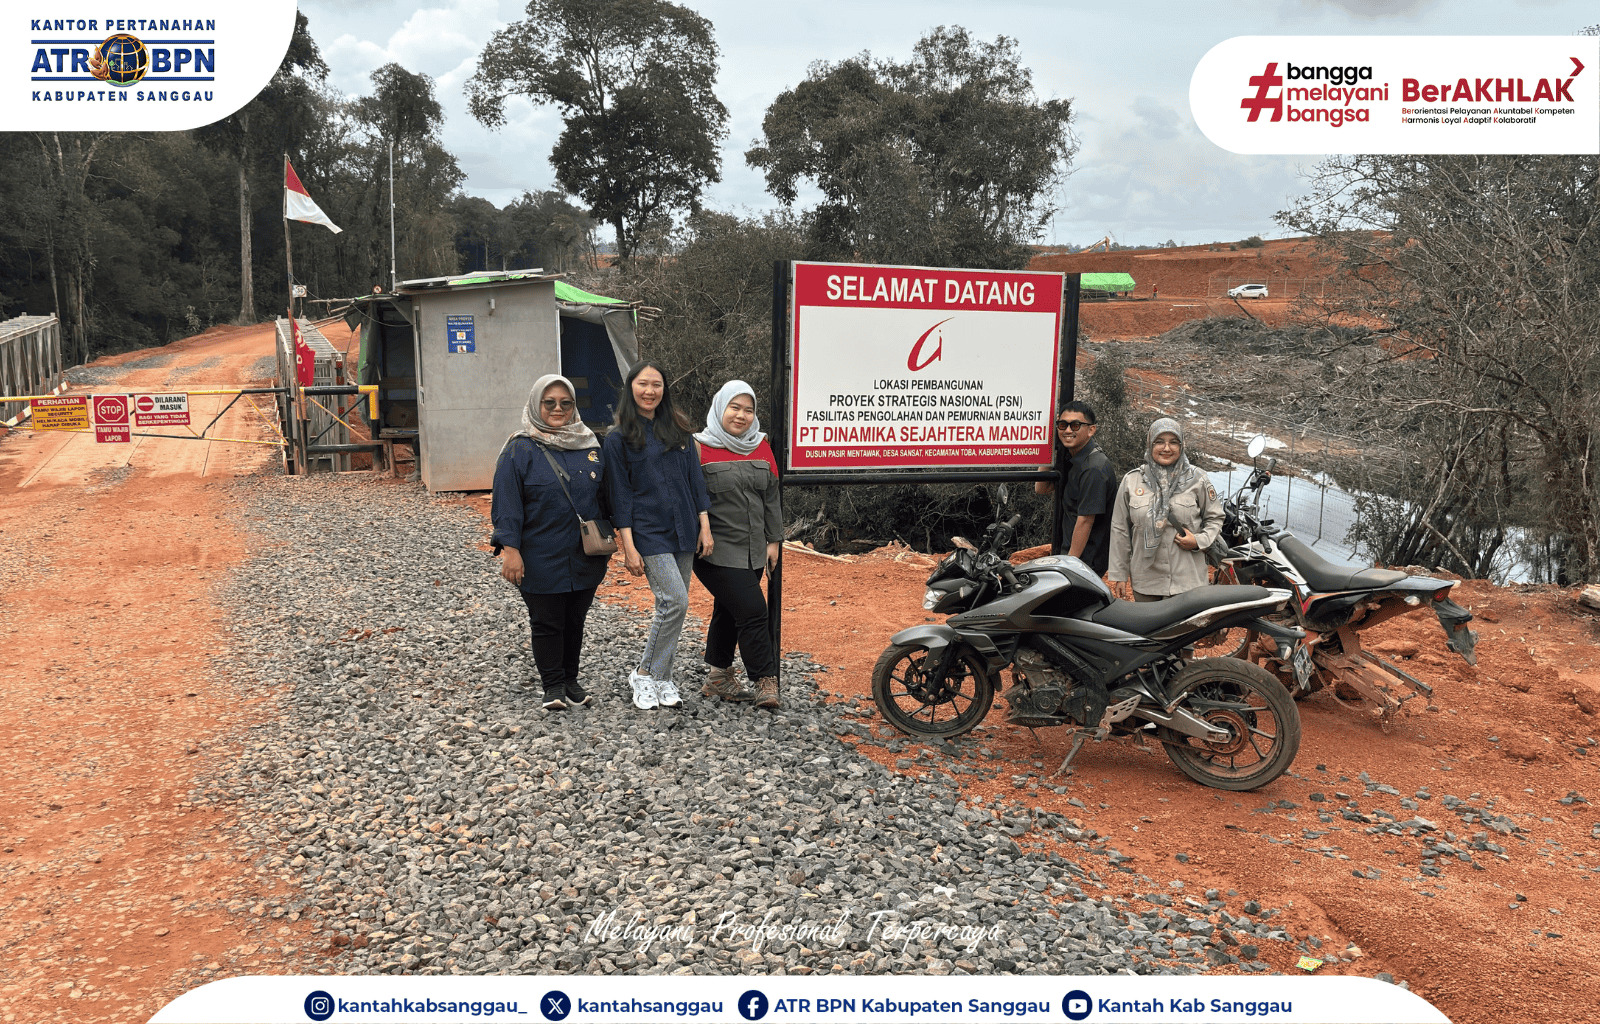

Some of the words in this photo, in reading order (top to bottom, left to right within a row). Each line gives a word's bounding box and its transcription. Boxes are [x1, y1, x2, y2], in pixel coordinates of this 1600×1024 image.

[826, 275, 938, 303] SELAMAT
[944, 279, 1036, 306] DATANG
[873, 379, 909, 390] LOKASI
[911, 379, 984, 391] PEMBANGUNAN
[37, 398, 80, 406] PERHATIAN
[154, 396, 186, 404] DILARANG
[829, 394, 875, 407] PROYEK
[877, 394, 937, 407] STRATEGIS
[939, 395, 993, 407] NASIONAL
[995, 395, 1023, 409] (PSN)
[100, 405, 122, 415] STOP
[159, 403, 182, 411] MASUK
[806, 410, 855, 422] FASILITAS
[857, 410, 923, 422] PENGOLAHAN
[925, 410, 945, 421] DAN
[947, 410, 1001, 421] PEMURNIAN
[1003, 410, 1042, 421] BAUKSIT
[105, 434, 122, 442] LAPOR
[799, 426, 819, 443] PT
[823, 426, 897, 443] DINAMIKA
[899, 425, 985, 442] SEJAHTERA
[988, 425, 1047, 441] MANDIRI
[805, 450, 827, 458] DUSUN
[827, 450, 846, 458] PASIR
[847, 449, 882, 459] MENTAWAK,
[882, 449, 899, 457] DESA
[899, 449, 924, 457] SANSAT,
[924, 448, 960, 457] KECAMATAN
[978, 448, 1012, 456] KABUPATEN
[1012, 447, 1040, 455] SANGGAU
